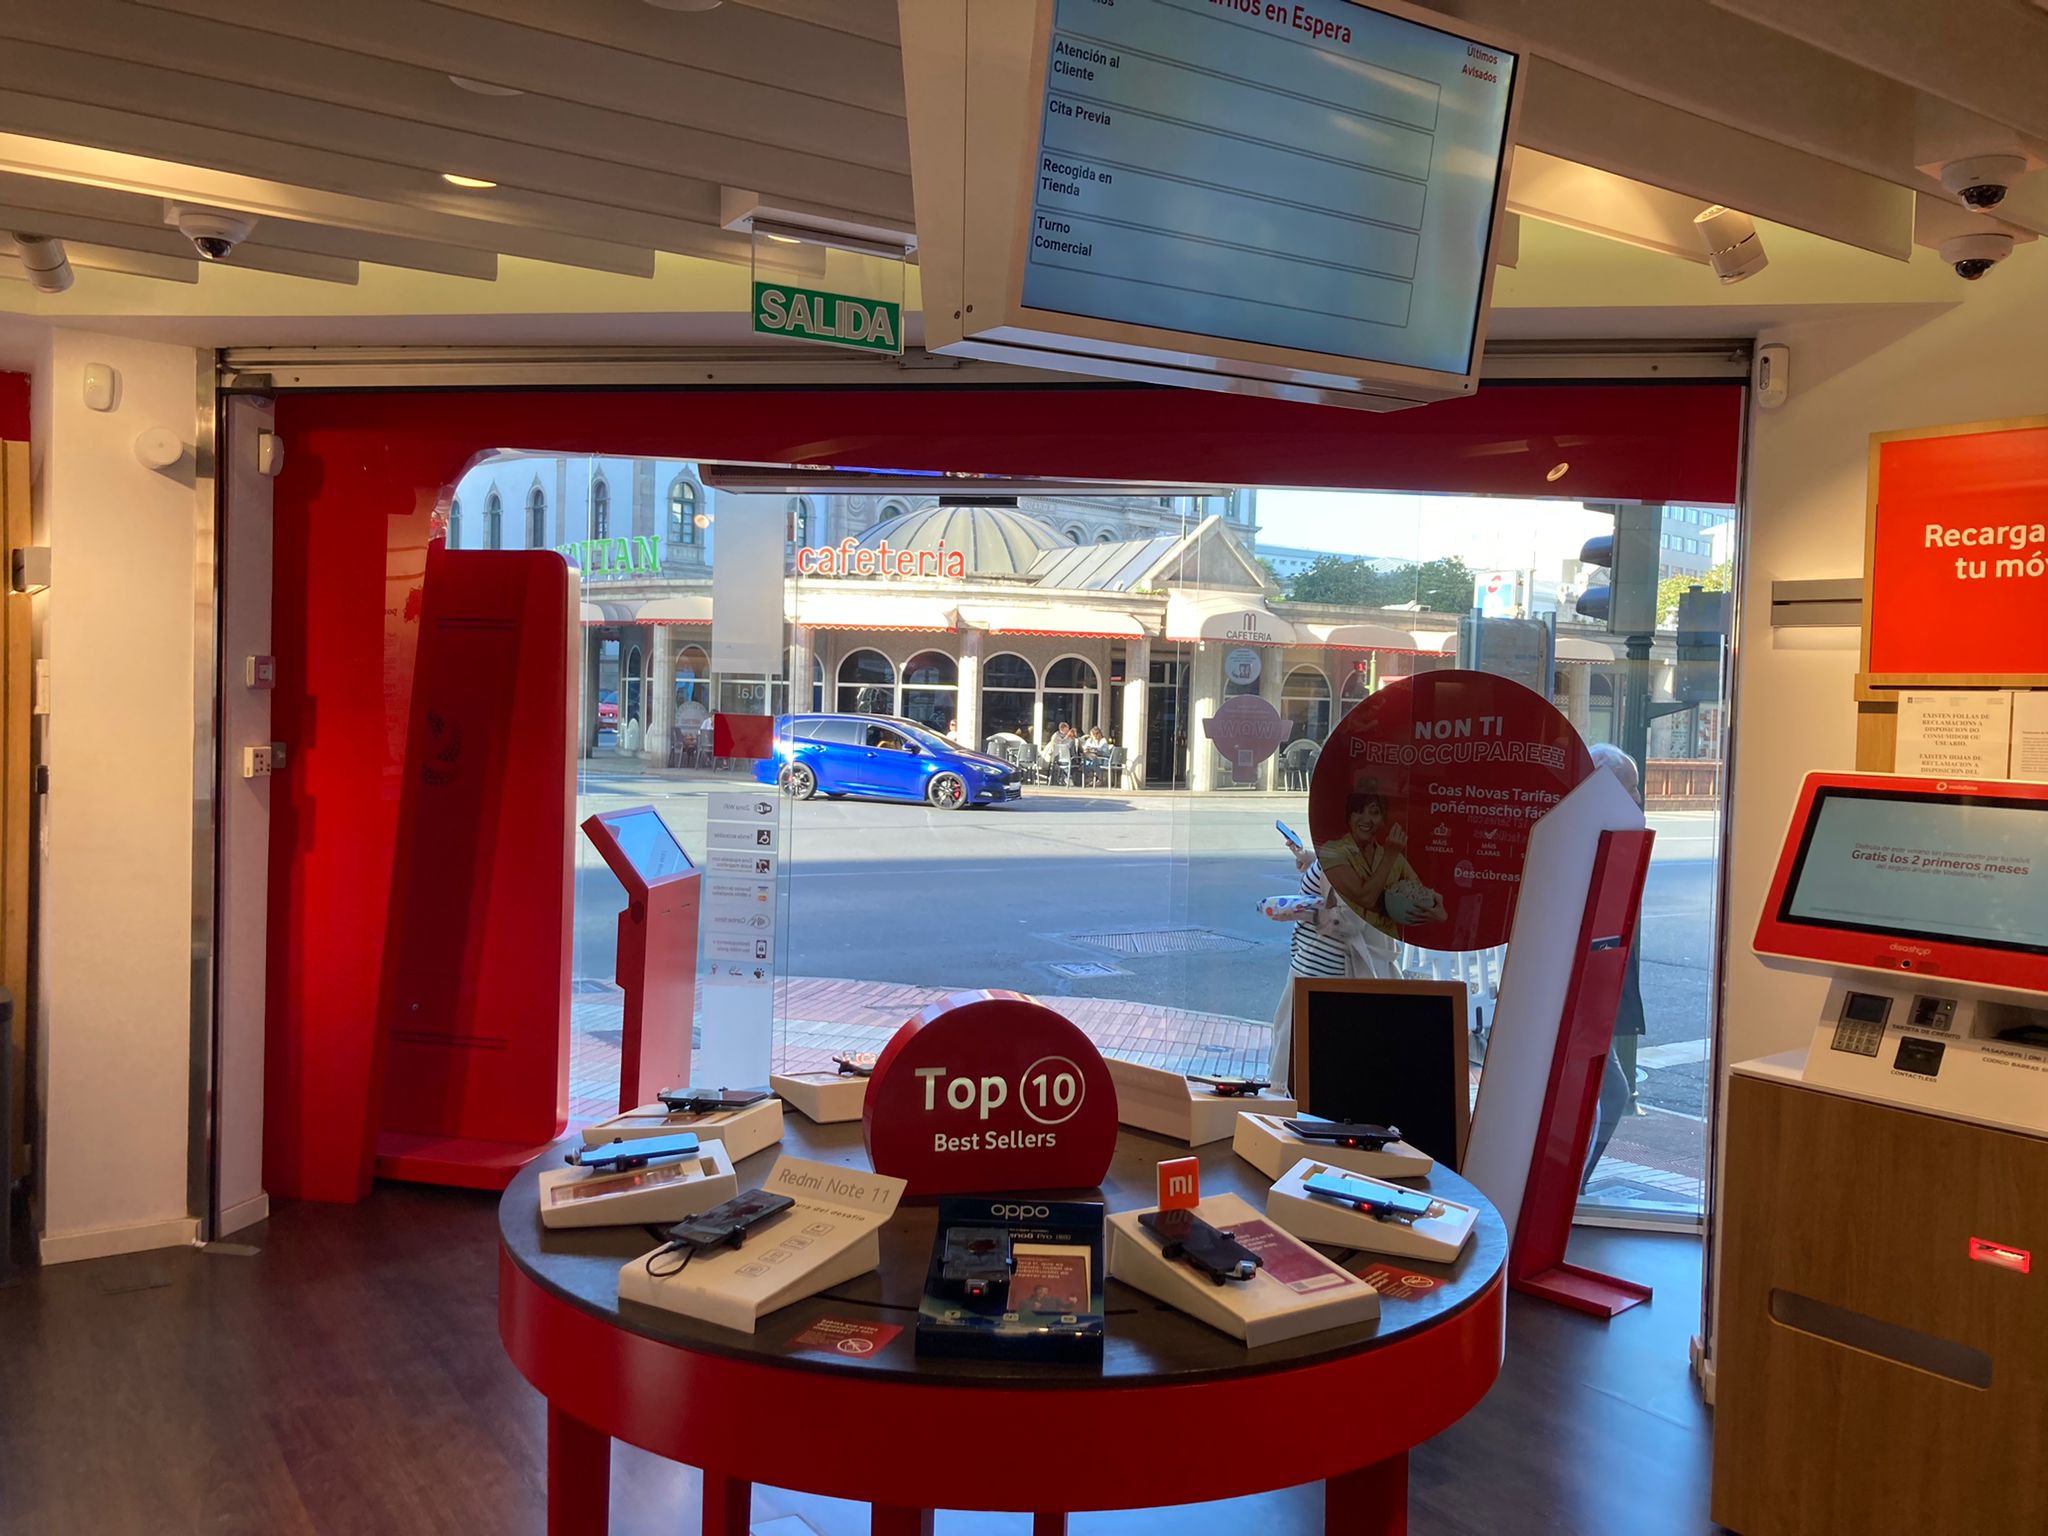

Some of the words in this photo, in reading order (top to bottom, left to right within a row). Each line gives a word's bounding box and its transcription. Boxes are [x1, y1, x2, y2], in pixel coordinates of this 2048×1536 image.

[1265, 4, 1288, 24] en
[1292, 7, 1351, 44] Espera
[1056, 41, 1106, 65] Atención
[1109, 55, 1120, 68] al
[1467, 44, 1498, 65] Últimos
[1054, 60, 1095, 81] Cliente
[1462, 64, 1497, 83] Avisados
[1049, 100, 1072, 116] Cita
[1075, 106, 1111, 125] Previa
[1043, 158, 1095, 181] Recogida
[1098, 173, 1112, 184] en
[1041, 177, 1080, 196] Tienda
[1037, 216, 1070, 234] Turno
[1035, 235, 1092, 256] Comercial
[759, 289, 894, 345] SALIDA
[1925, 524, 2045, 550] Recarga
[797, 536, 966, 578] cafeteria
[1955, 557, 1986, 579] tu
[1996, 551, 2048, 578] mó
[1226, 631, 1272, 641] CAFETERIA
[1415, 718, 1471, 740] NON
[1479, 716, 1503, 736] TI
[1428, 782, 1462, 797] Coas
[1465, 785, 1509, 800] Novas
[1512, 788, 1560, 803] Tarifas
[1431, 800, 1522, 818] poñémoscho
[1525, 806, 1548, 819] fác
[1851, 850, 1887, 863] Gratis
[1890, 853, 1909, 864] los
[1912, 855, 1920, 865] 2
[1922, 857, 1981, 871] primeros
[1984, 863, 2029, 875] meses
[1892, 1024, 1919, 1033] TARJETA
[1891, 1069, 1937, 1083] CONTACTLESS
[914, 1066, 1007, 1120] Top
[1031, 1073, 1076, 1107] 10
[934, 1133, 980, 1152] Best
[985, 1130, 1056, 1150] Sellers
[778, 1168, 824, 1190] Redmi
[826, 1178, 865, 1199] Note
[872, 1187, 890, 1203] 11
[991, 1203, 1049, 1220] oppo
